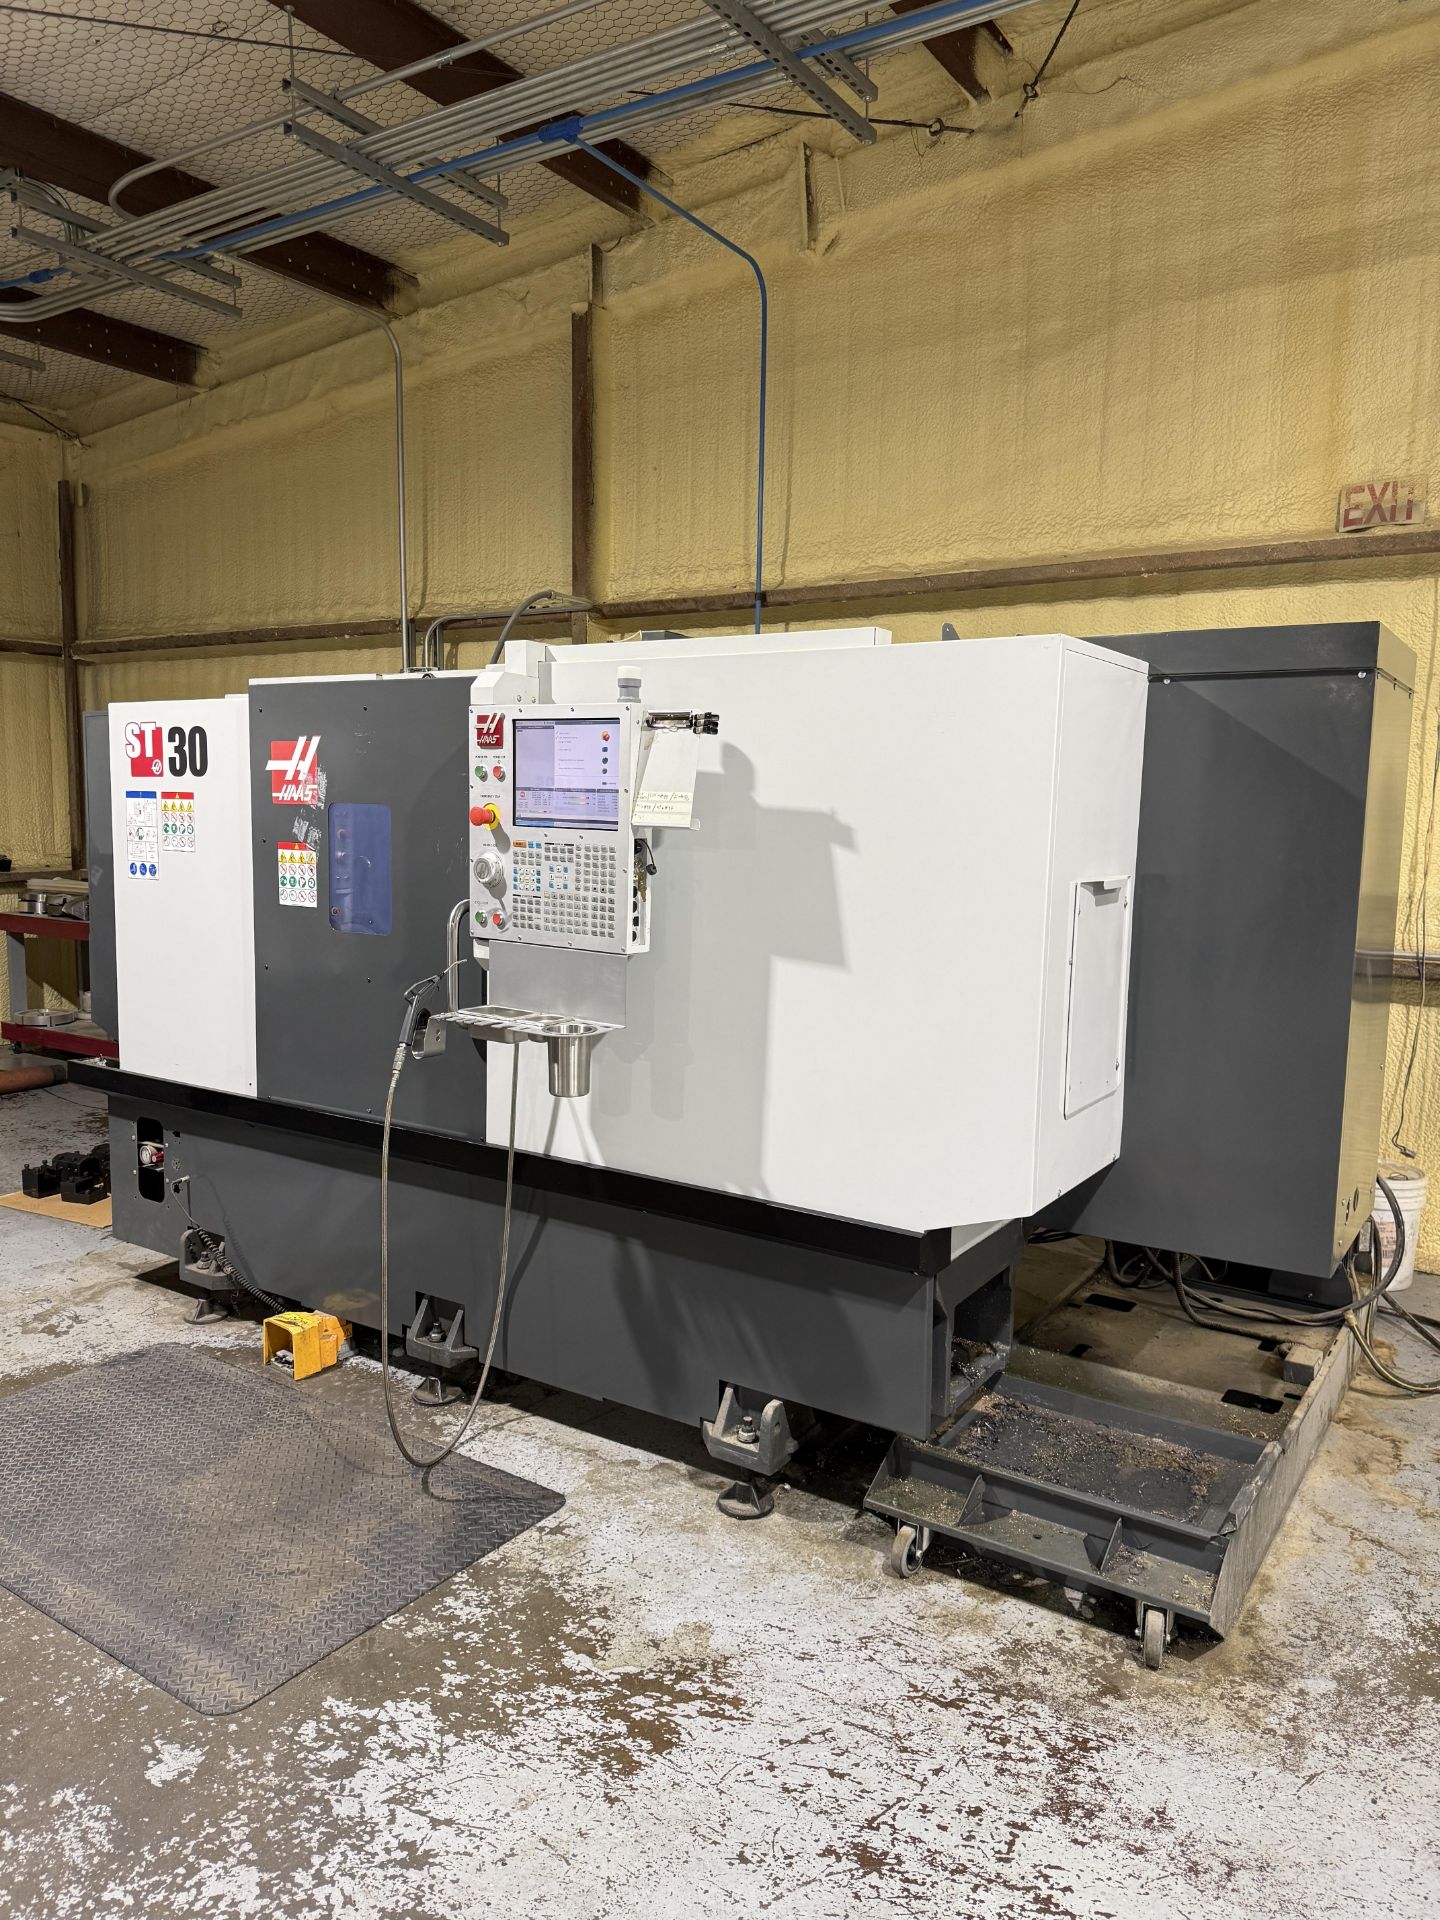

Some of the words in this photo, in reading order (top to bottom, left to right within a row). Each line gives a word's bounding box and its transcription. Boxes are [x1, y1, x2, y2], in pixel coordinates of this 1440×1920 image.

[477, 735, 500, 744] HAAS
[125, 721, 157, 759] ST
[167, 725, 208, 777] 30
[272, 785, 318, 801] HAAS
